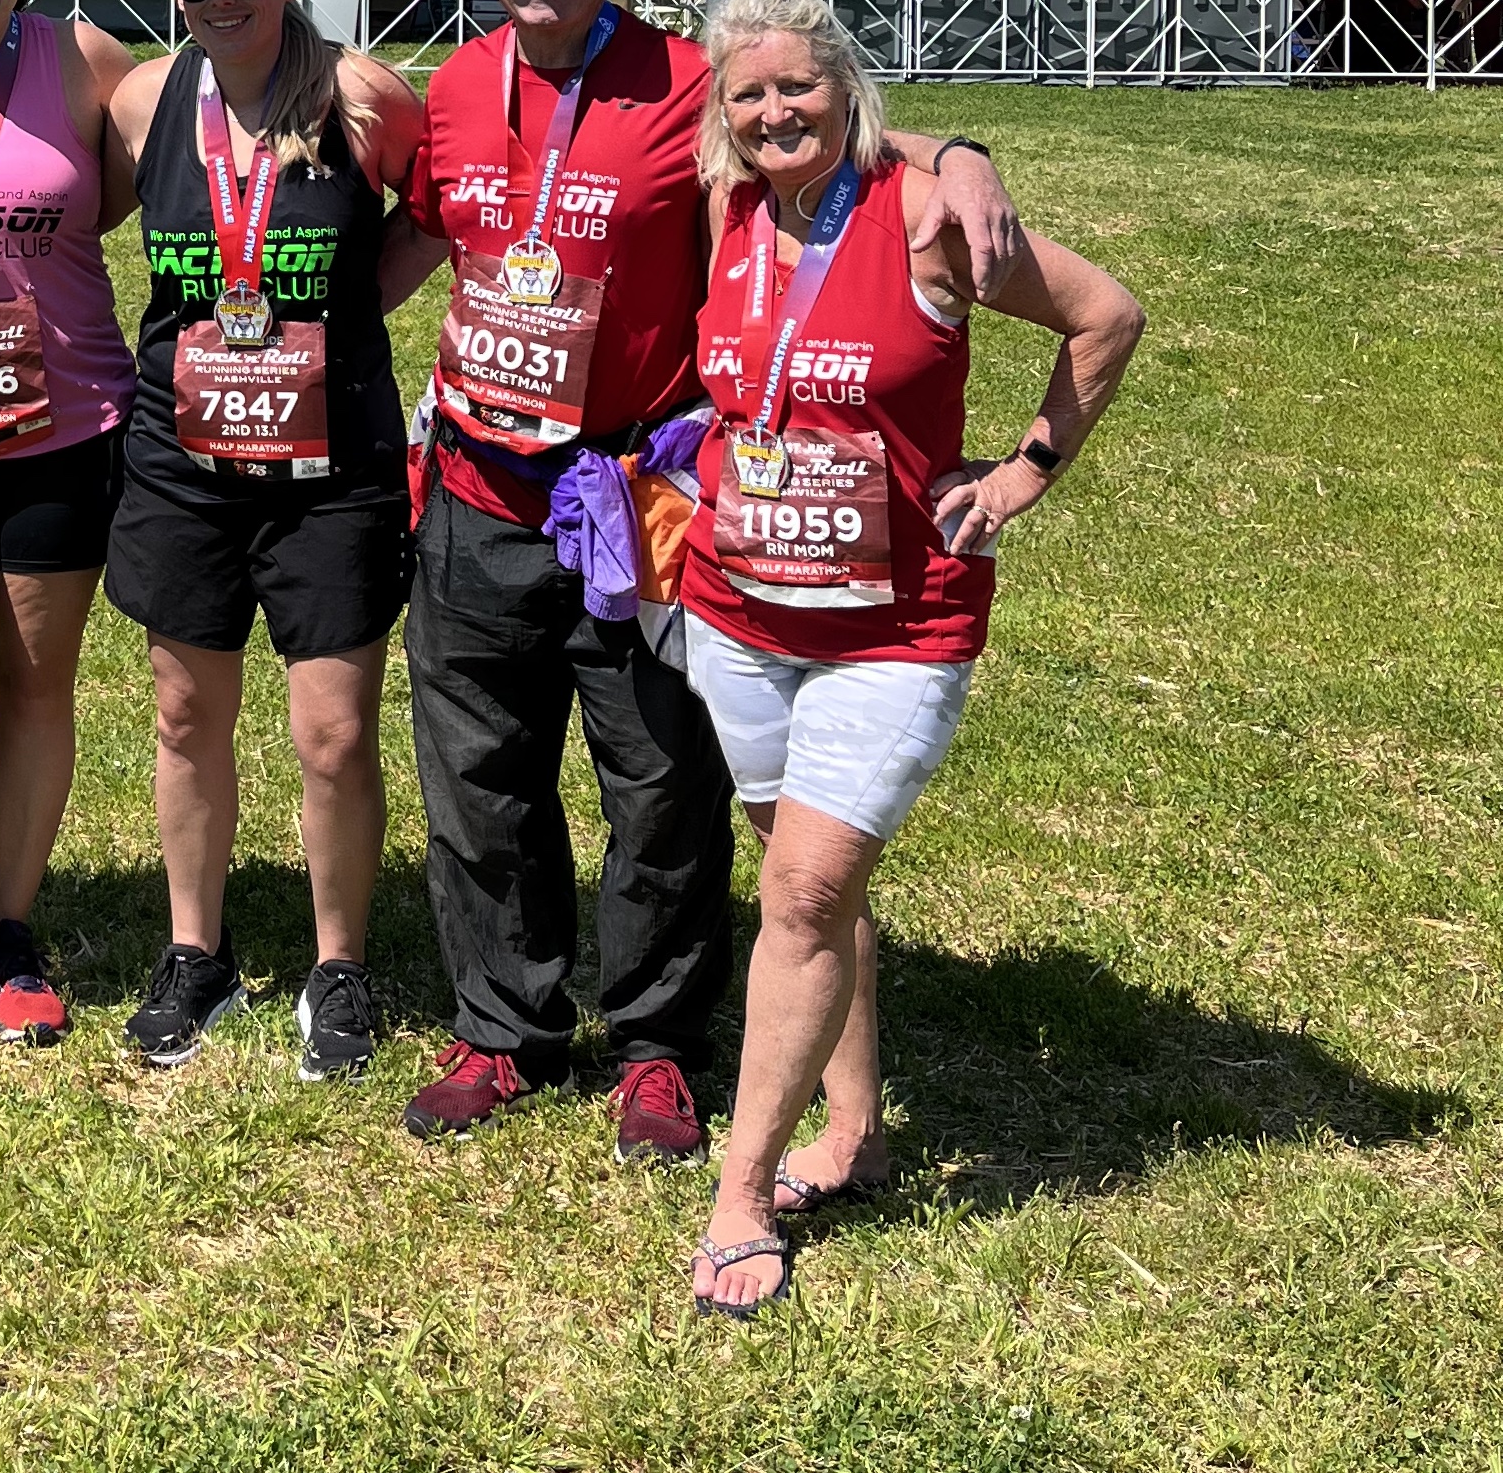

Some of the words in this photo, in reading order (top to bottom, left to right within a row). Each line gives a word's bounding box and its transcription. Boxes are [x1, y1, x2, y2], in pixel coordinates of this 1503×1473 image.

[477, 164, 495, 174] run
[581, 170, 620, 187] Asprin
[534, 148, 559, 224] MARATHON
[28, 190, 68, 203] Asprin
[214, 156, 234, 225] NASHVILLE
[248, 156, 272, 228] MARATHON
[449, 176, 618, 215] JACON
[831, 181, 851, 219] JUDE
[480, 206, 513, 230] RU
[150, 230, 163, 242] We
[165, 232, 186, 242] run
[190, 231, 207, 241] on
[265, 227, 291, 239] and
[295, 226, 338, 240] Asprin
[243, 228, 257, 263] HALF
[181, 278, 227, 302] RU
[751, 243, 767, 318] NASHVILLE
[468, 299, 519, 320] RUNNING
[521, 313, 568, 332] SERIES
[482, 313, 548, 337] NASHVILLE
[185, 347, 243, 363] Rock
[262, 348, 310, 364] Roll
[457, 325, 568, 383] 10031
[806, 338, 829, 349] and
[831, 339, 874, 352] Asprin
[701, 349, 873, 383] JASON
[765, 318, 797, 397] MARATHON
[195, 365, 251, 374] RUNNING
[253, 365, 299, 375] SERIES
[214, 375, 282, 384] NASHVILLE
[461, 360, 553, 395] ROCKETMAN
[463, 380, 485, 395] HALF
[486, 389, 546, 411] MARATHON
[792, 381, 866, 405] CLUB
[199, 390, 299, 422] 7847
[758, 396, 773, 425] ALF
[221, 424, 251, 436] 2ND
[254, 425, 279, 437] 13.1
[209, 442, 234, 451] HALF
[237, 443, 293, 453] MARATHON
[803, 442, 836, 455] JUDE
[809, 457, 869, 476] Roll
[802, 477, 855, 488] SERIES
[740, 503, 863, 543] 11959
[766, 542, 790, 556] RN
[794, 544, 834, 558] MOM
[752, 563, 782, 574] HALF
[784, 563, 850, 576] MARATHON
